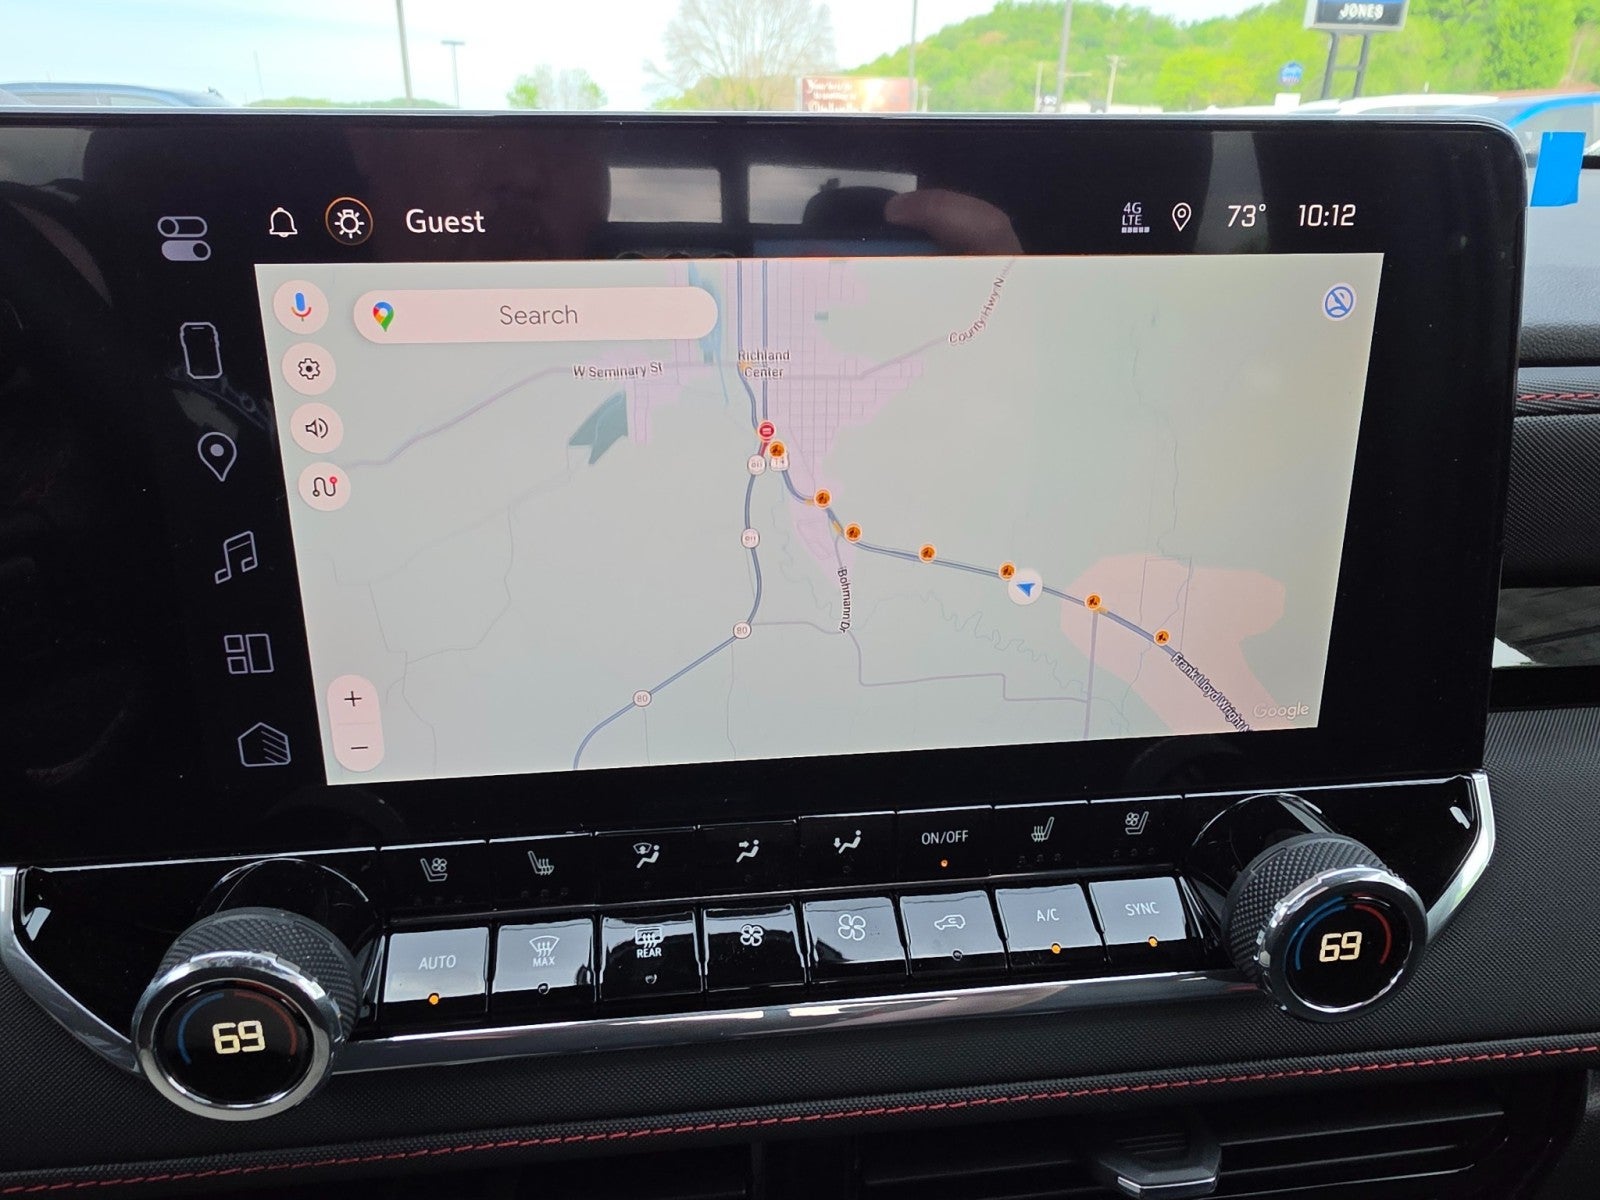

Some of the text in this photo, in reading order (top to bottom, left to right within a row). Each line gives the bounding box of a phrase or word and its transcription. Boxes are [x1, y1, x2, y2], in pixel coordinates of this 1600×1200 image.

[1339, 3, 1384, 20] JONES
[1123, 202, 1142, 214] 4G
[1227, 203, 1267, 228] 73°
[1298, 203, 1357, 227] 10:12
[405, 208, 486, 233] Guest
[1121, 214, 1142, 226] LTE
[499, 304, 578, 326] Search
[949, 315, 987, 344] County
[737, 350, 790, 361] Richland
[573, 362, 663, 379] W Seminary St
[744, 366, 784, 378] Center
[837, 568, 851, 634] Bohmann Dr
[1171, 652, 1200, 682] Frank
[1194, 675, 1223, 704] Lloyd
[1217, 695, 1245, 729] Wright
[1253, 700, 1309, 719] Google
[921, 829, 969, 845] ON/OFF
[1036, 908, 1060, 922] A/C
[1124, 901, 1160, 917] SYNC
[636, 947, 662, 959] REAR
[1319, 931, 1362, 962] 69
[418, 955, 457, 970] AUTO
[532, 957, 555, 968] MAX
[212, 1020, 266, 1054] 69
